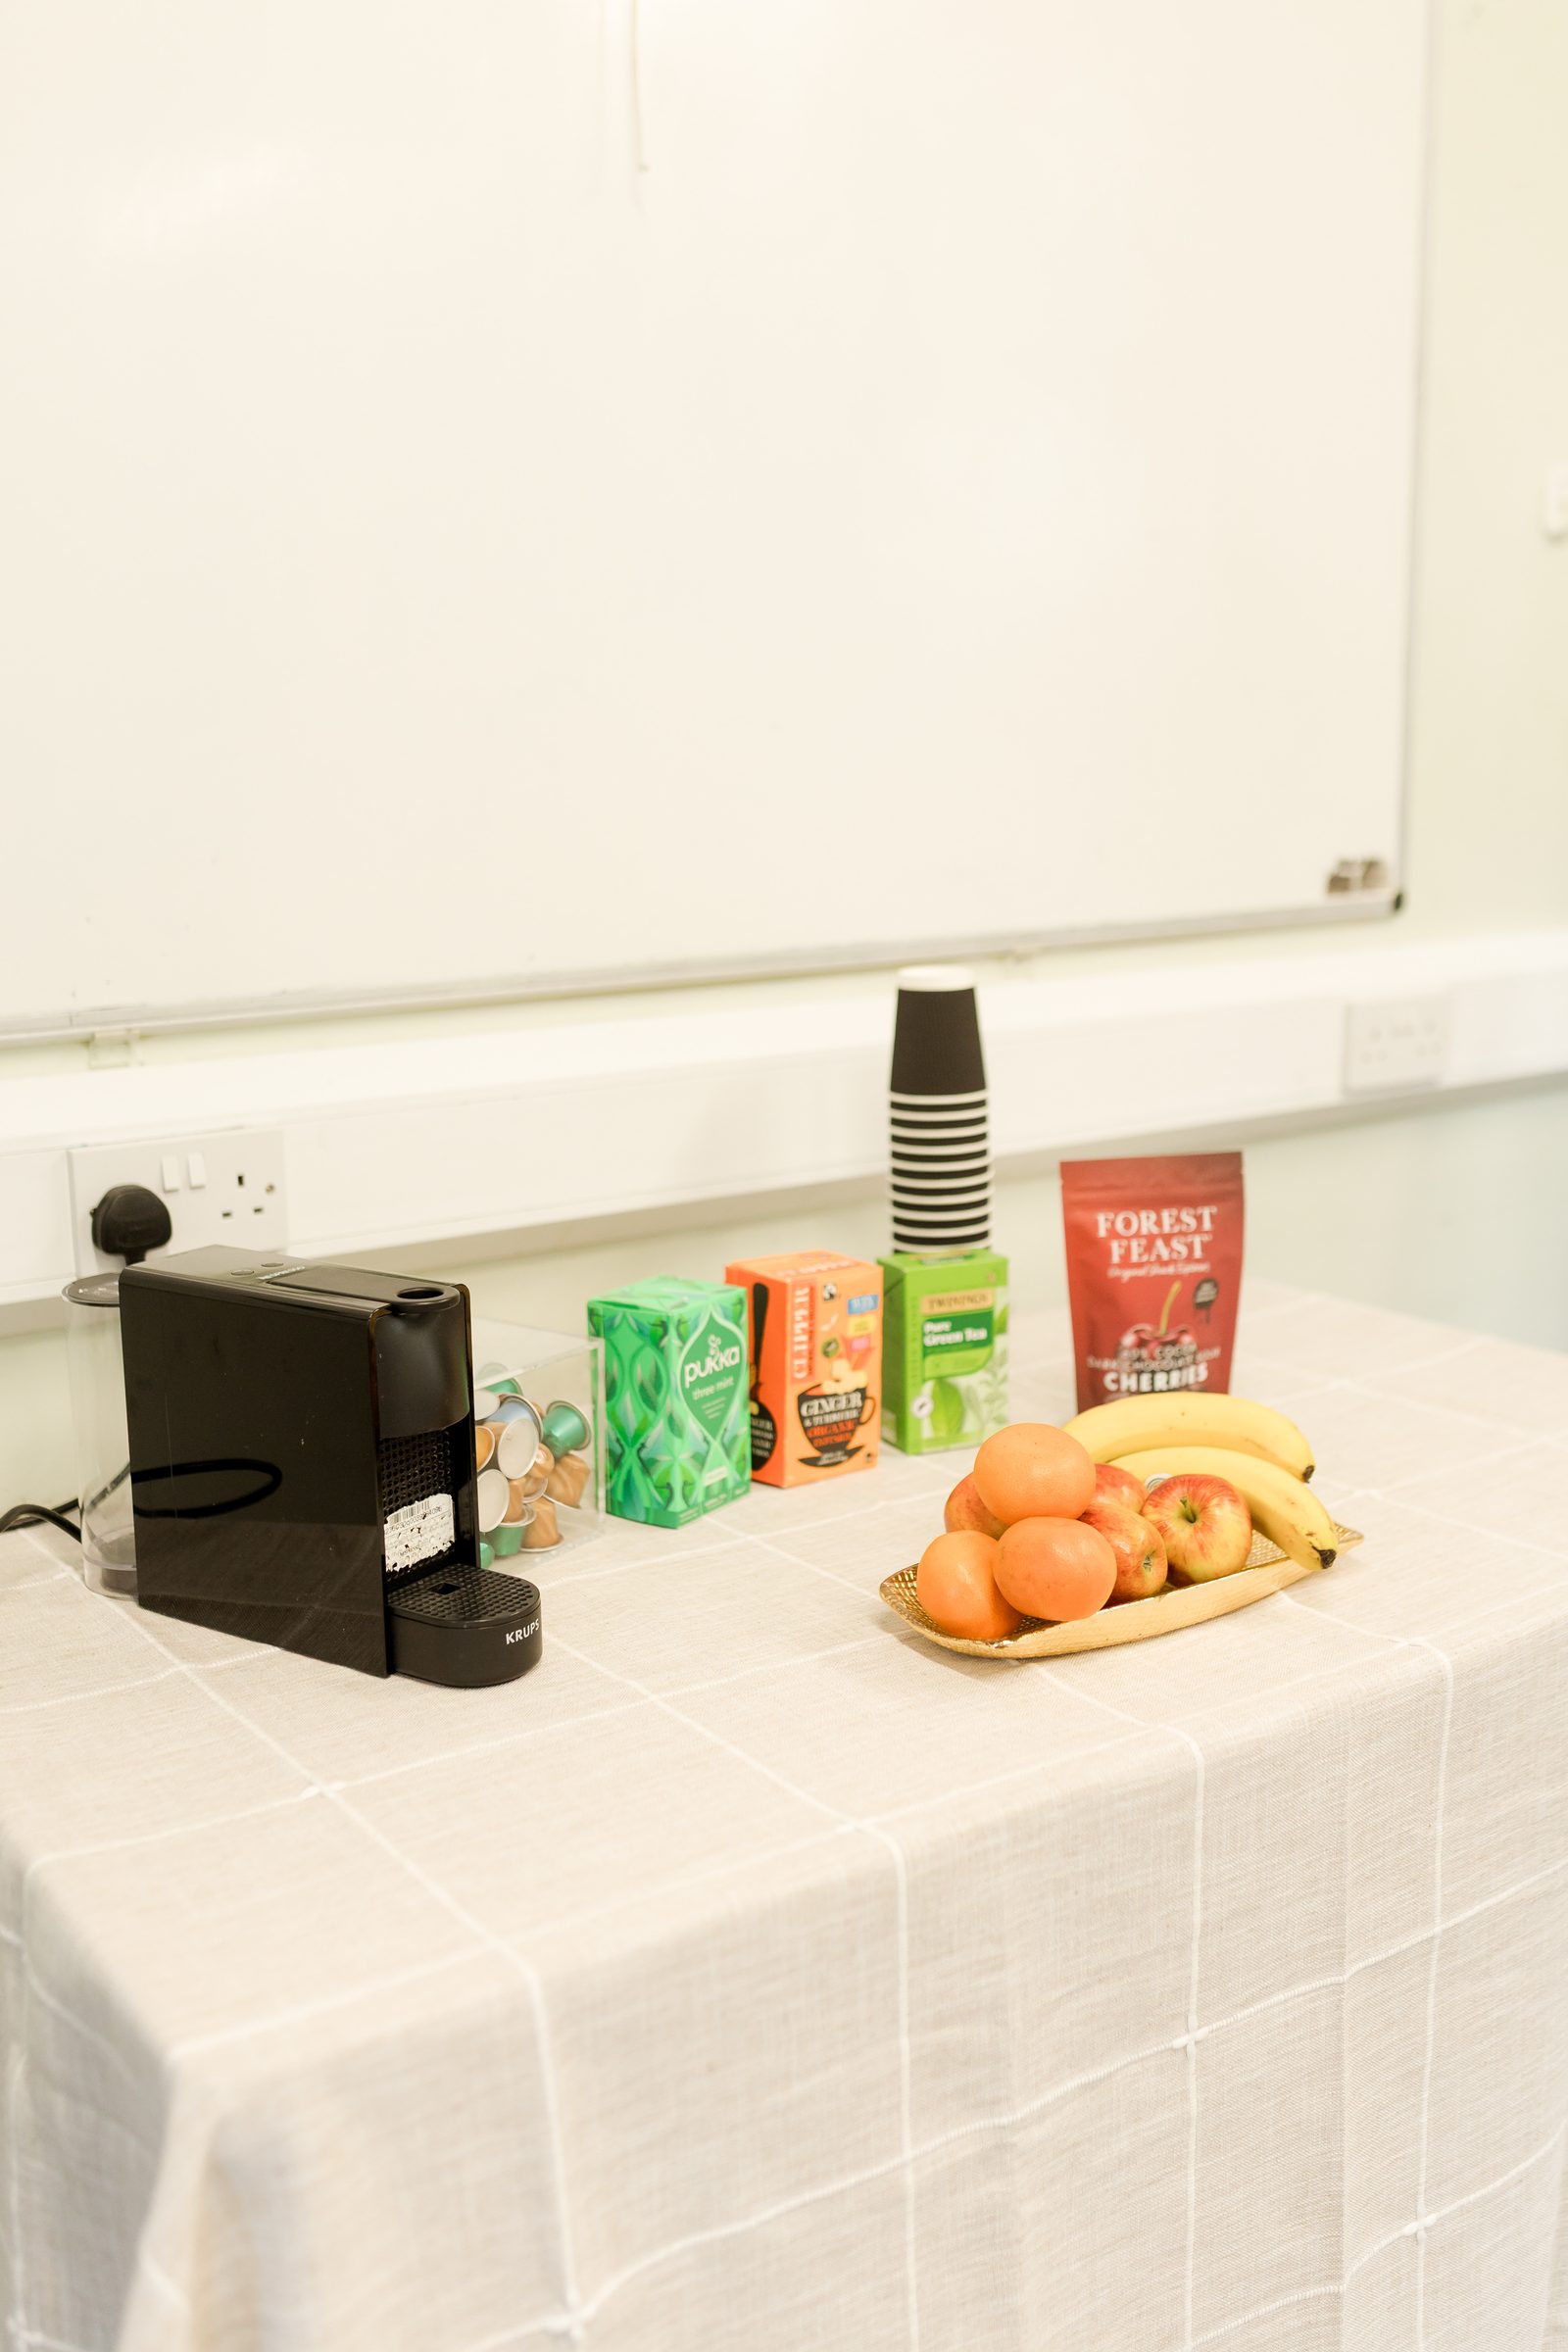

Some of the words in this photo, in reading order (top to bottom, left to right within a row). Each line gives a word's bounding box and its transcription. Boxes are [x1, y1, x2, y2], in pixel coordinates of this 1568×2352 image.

[1096, 1205, 1217, 1238] FOREST
[1109, 1234, 1212, 1264] FEAST
[964, 1328, 988, 1343] Tea
[684, 1346, 741, 1389] pukka
[1102, 1362, 1208, 1392] CHERRIES
[800, 1391, 862, 1418] GINGER
[505, 1618, 540, 1645] KRUPS
